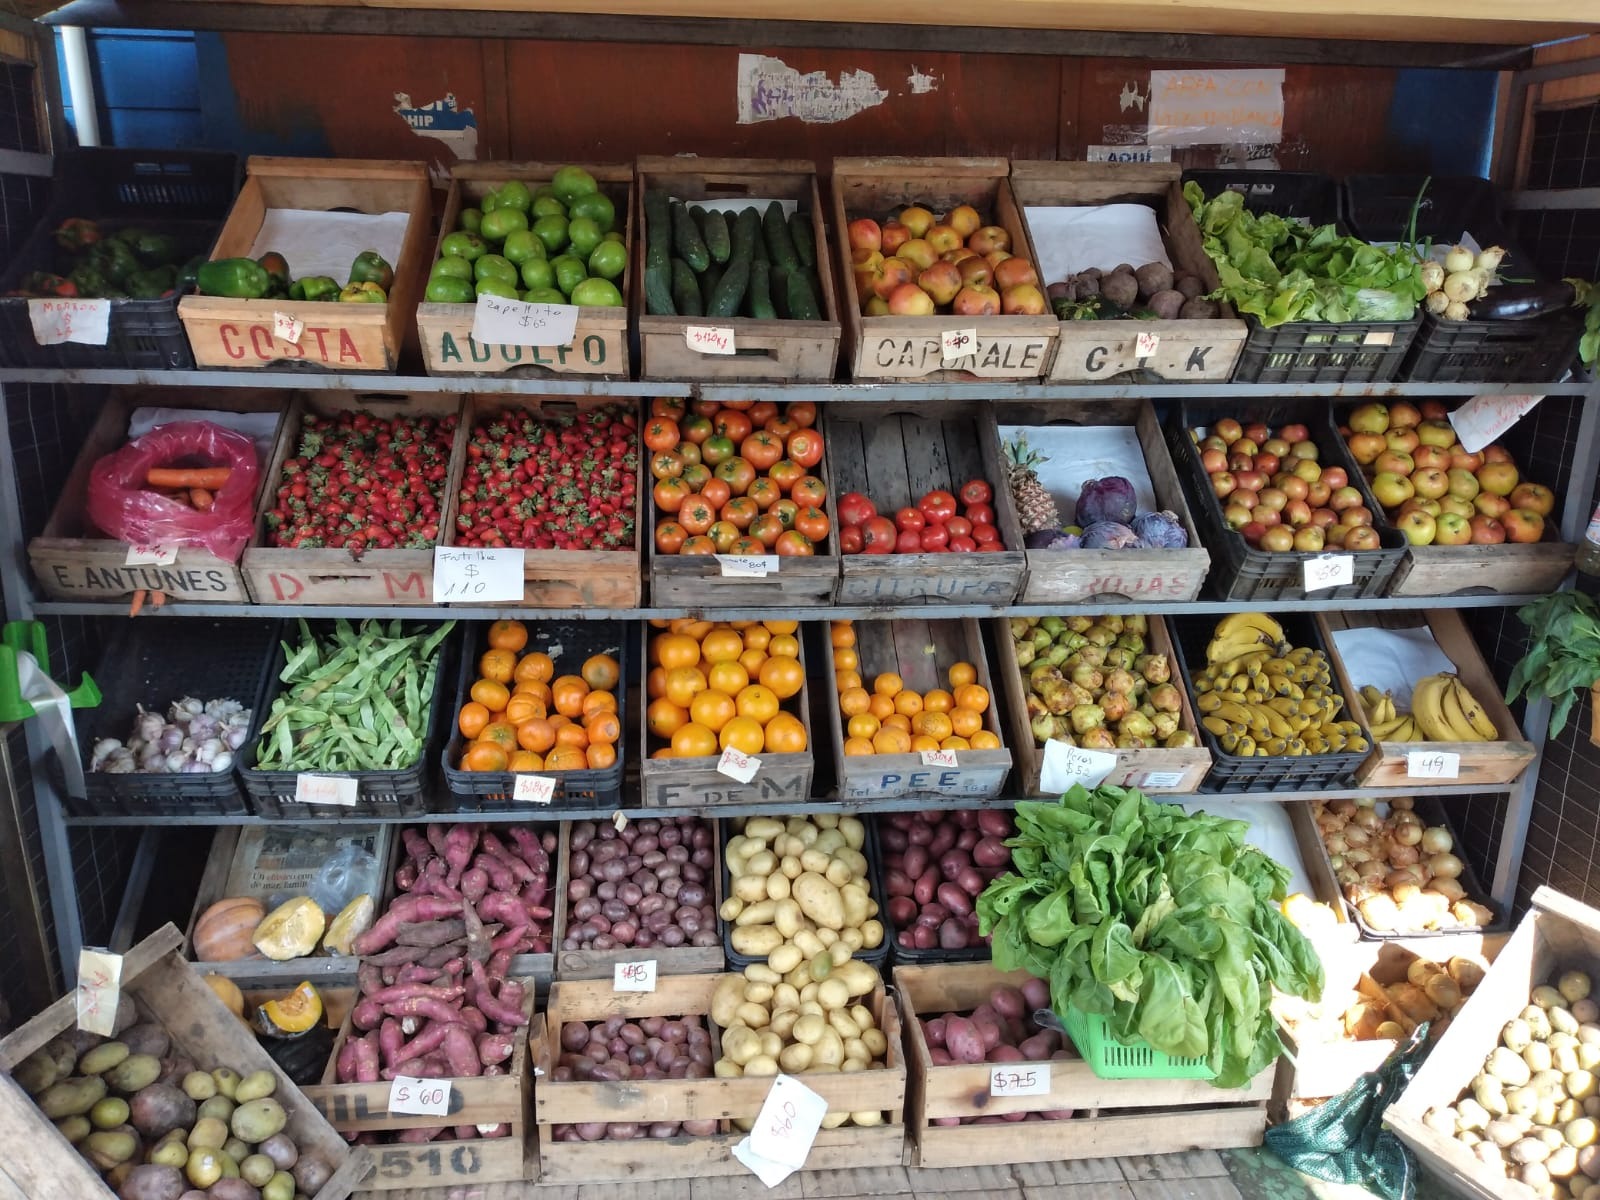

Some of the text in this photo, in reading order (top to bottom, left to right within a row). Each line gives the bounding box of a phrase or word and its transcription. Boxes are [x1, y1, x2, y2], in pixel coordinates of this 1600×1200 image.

[52, 565, 228, 592] E.ANTUNES
[464, 564, 479, 577] $
[269, 571, 426, 600] D M
[420, 1088, 444, 1105] 60
